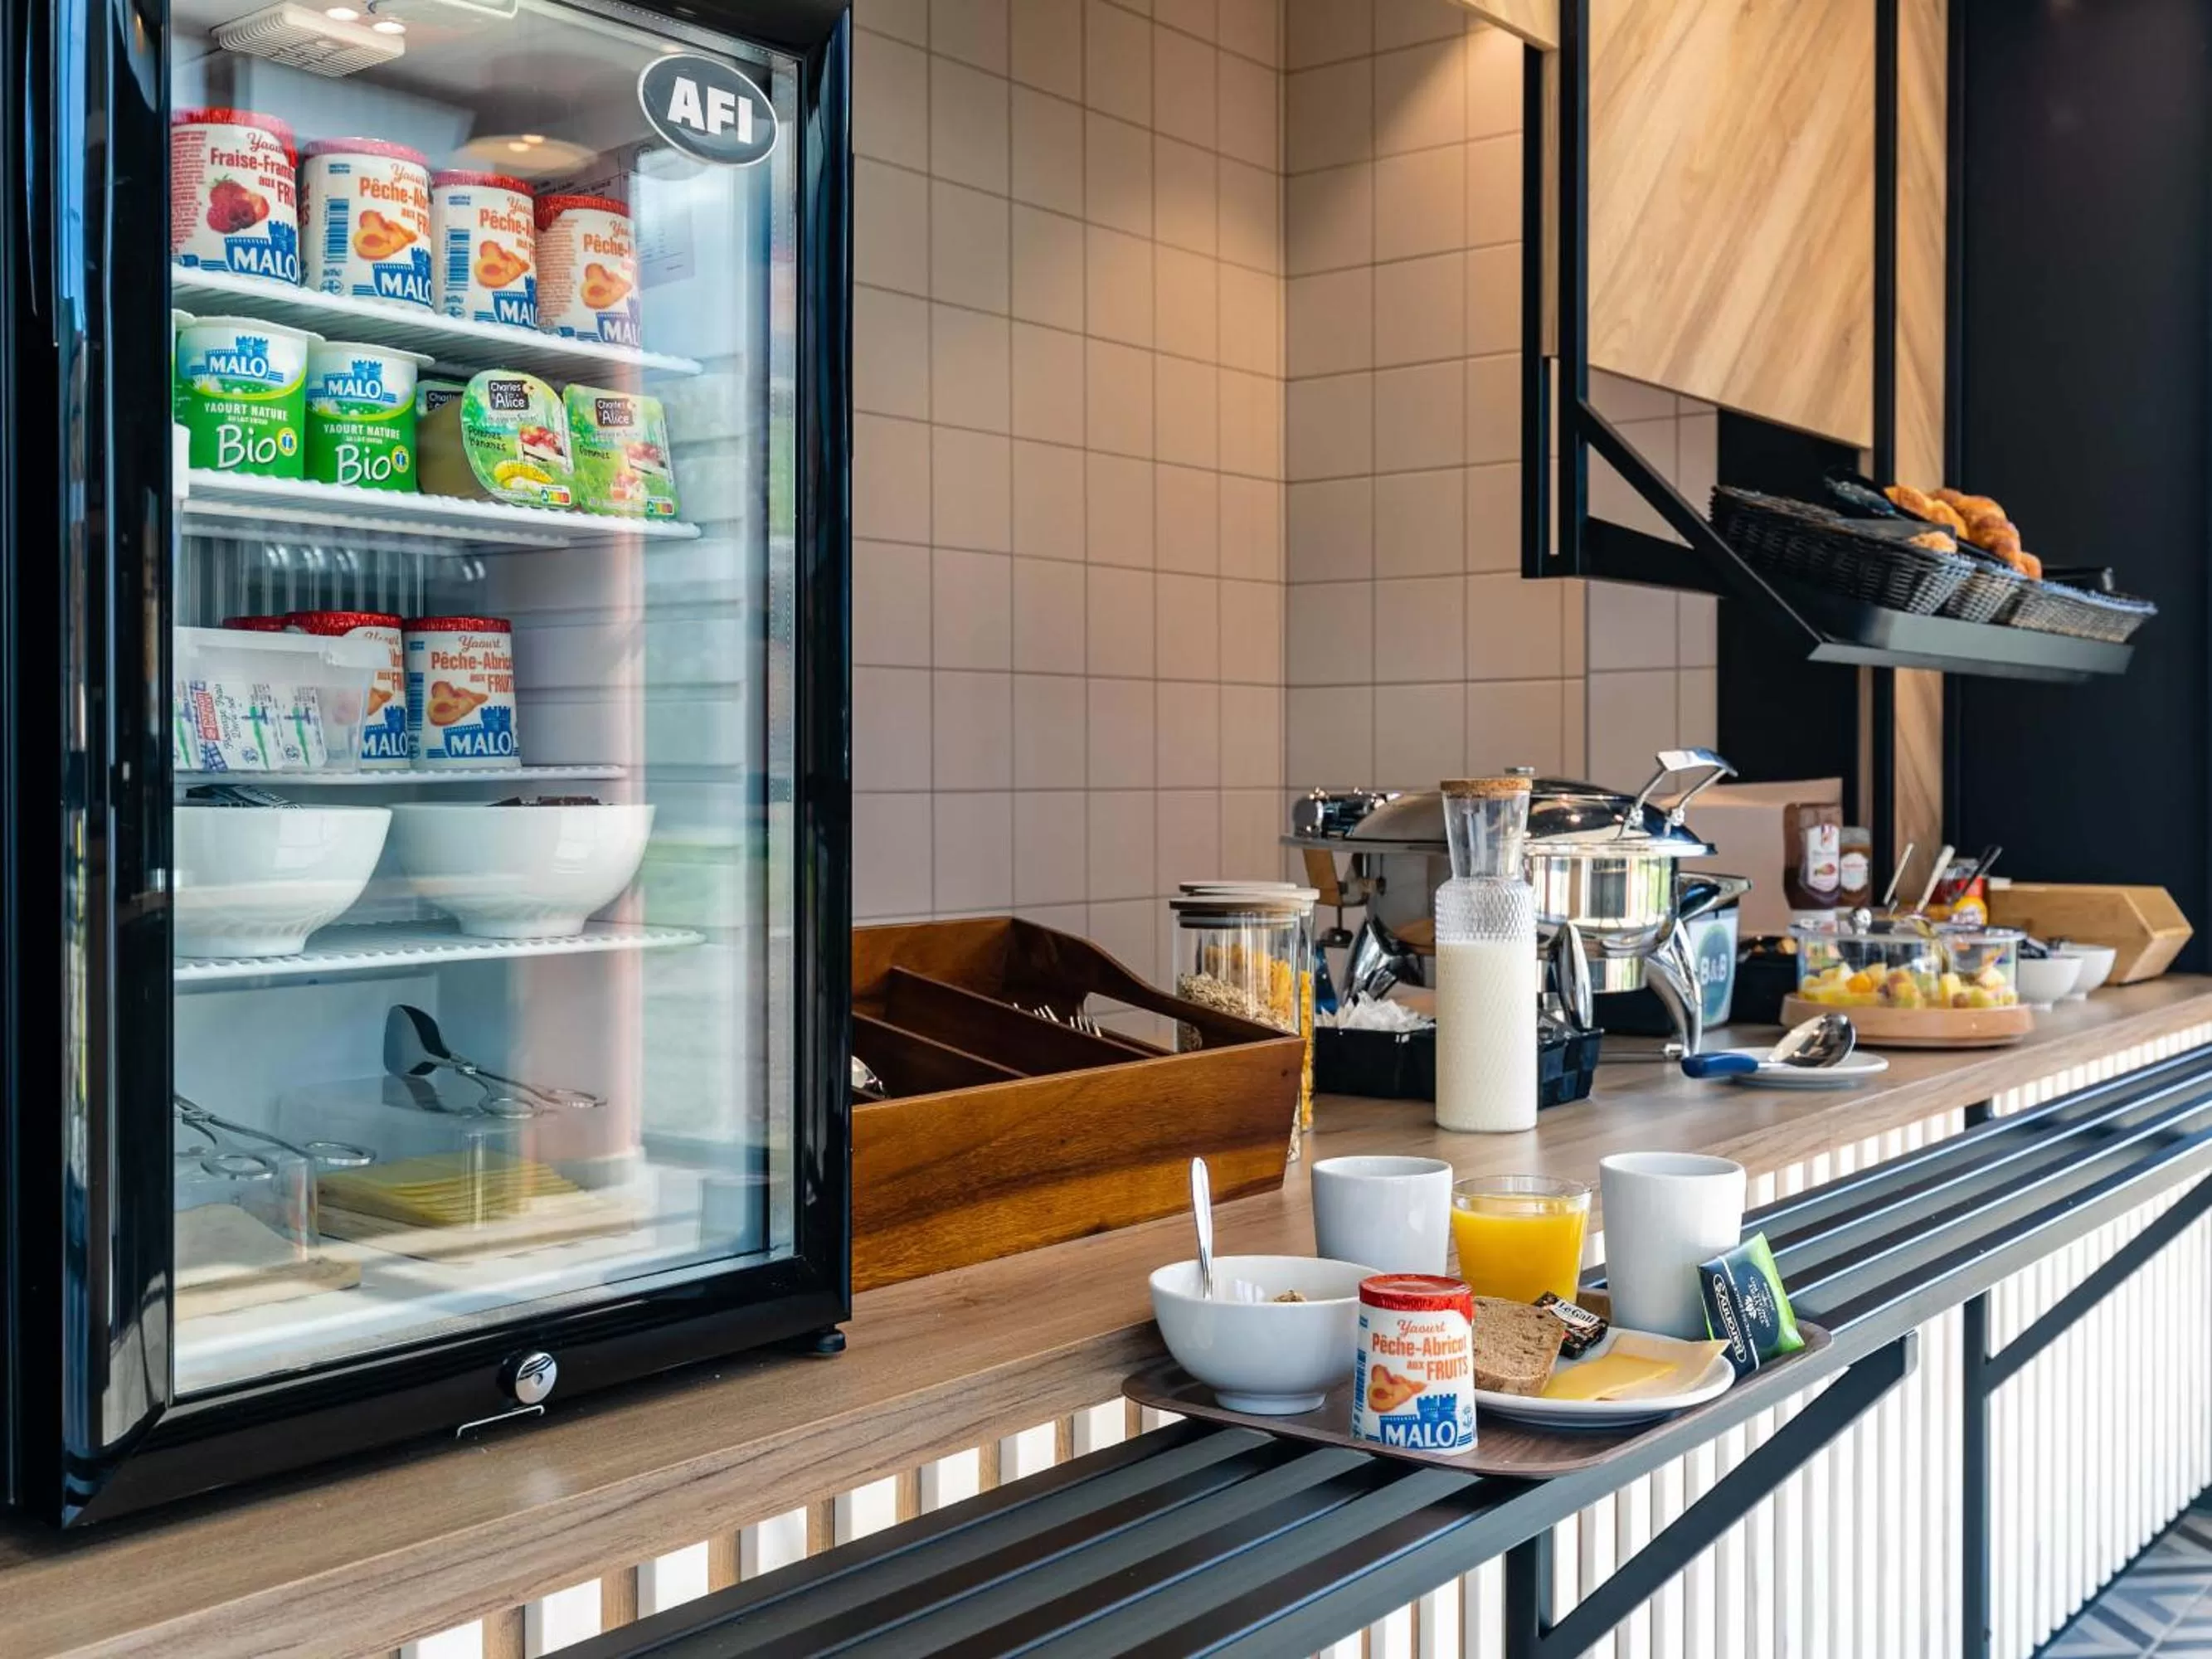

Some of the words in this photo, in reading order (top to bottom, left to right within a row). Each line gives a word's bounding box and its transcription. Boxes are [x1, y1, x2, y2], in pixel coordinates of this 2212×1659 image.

[667, 75, 752, 144] AFI
[234, 246, 297, 283] MALO
[209, 355, 268, 377] MALO
[328, 379, 382, 398] MALO
[490, 382, 522, 392] Charles
[495, 392, 525, 408] Alice
[204, 401, 247, 414] YAOURT
[251, 404, 289, 422] NATURE
[323, 424, 363, 435] YAOURT
[367, 426, 401, 440] NATURE
[216, 424, 277, 468] Bio
[334, 444, 392, 484] Bio
[459, 635, 501, 653] Yaourt
[450, 732, 513, 757] MALO
[1397, 1319, 1446, 1337] Yaourt
[1407, 1360, 1424, 1370] aux
[1427, 1355, 1468, 1380] FRUITS
[1385, 1420, 1456, 1447] MALO
